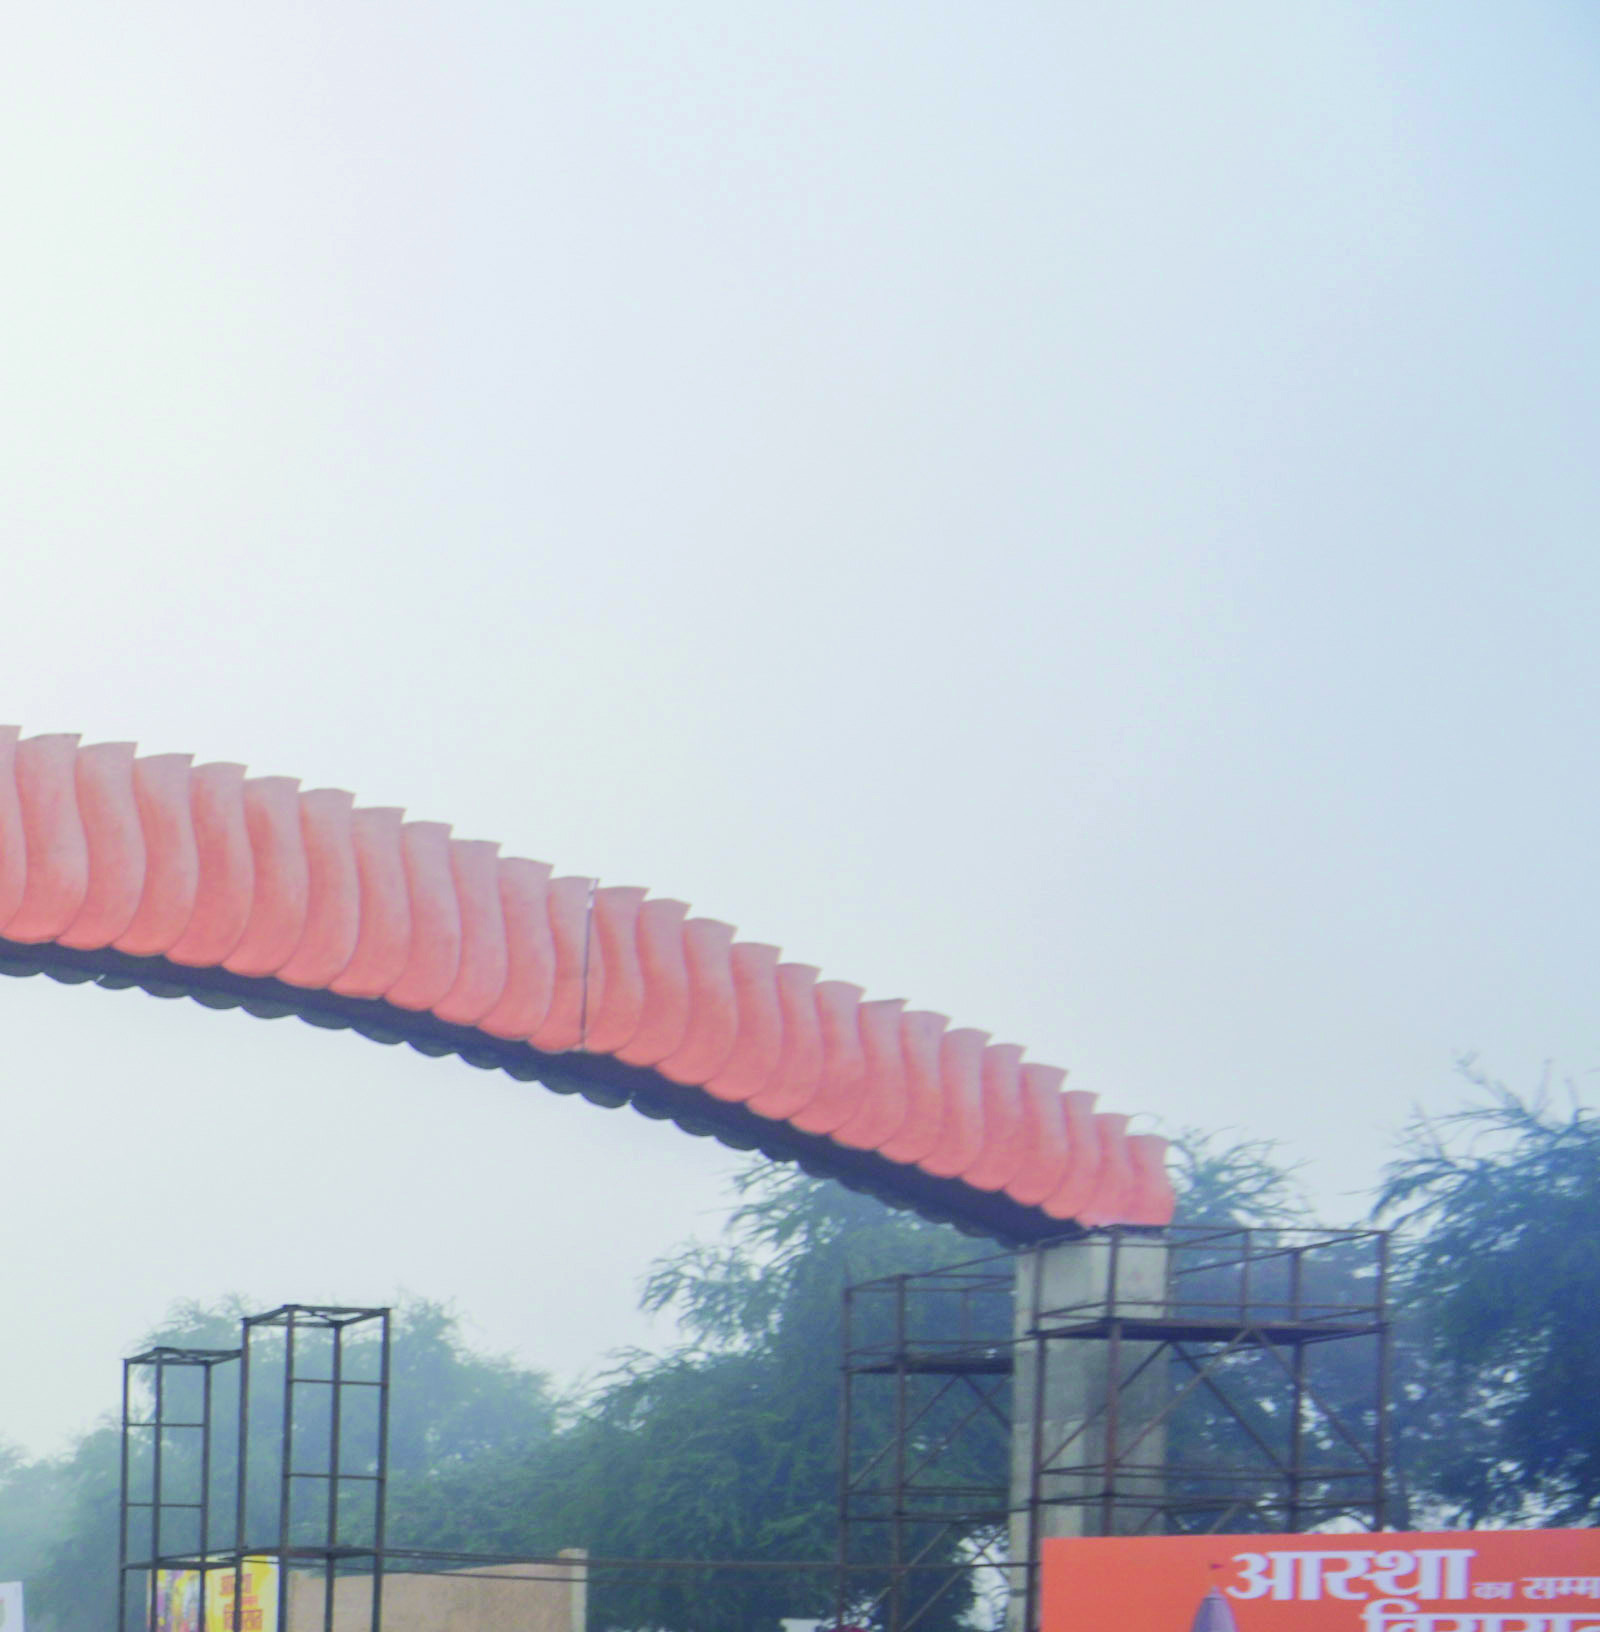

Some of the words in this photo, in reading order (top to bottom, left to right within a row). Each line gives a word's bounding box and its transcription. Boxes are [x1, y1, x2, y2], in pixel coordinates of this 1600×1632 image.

[1225, 1548, 1478, 1600] आस्था
[1472, 1581, 1514, 1599] का
[1520, 1576, 1600, 1599] सम्म
